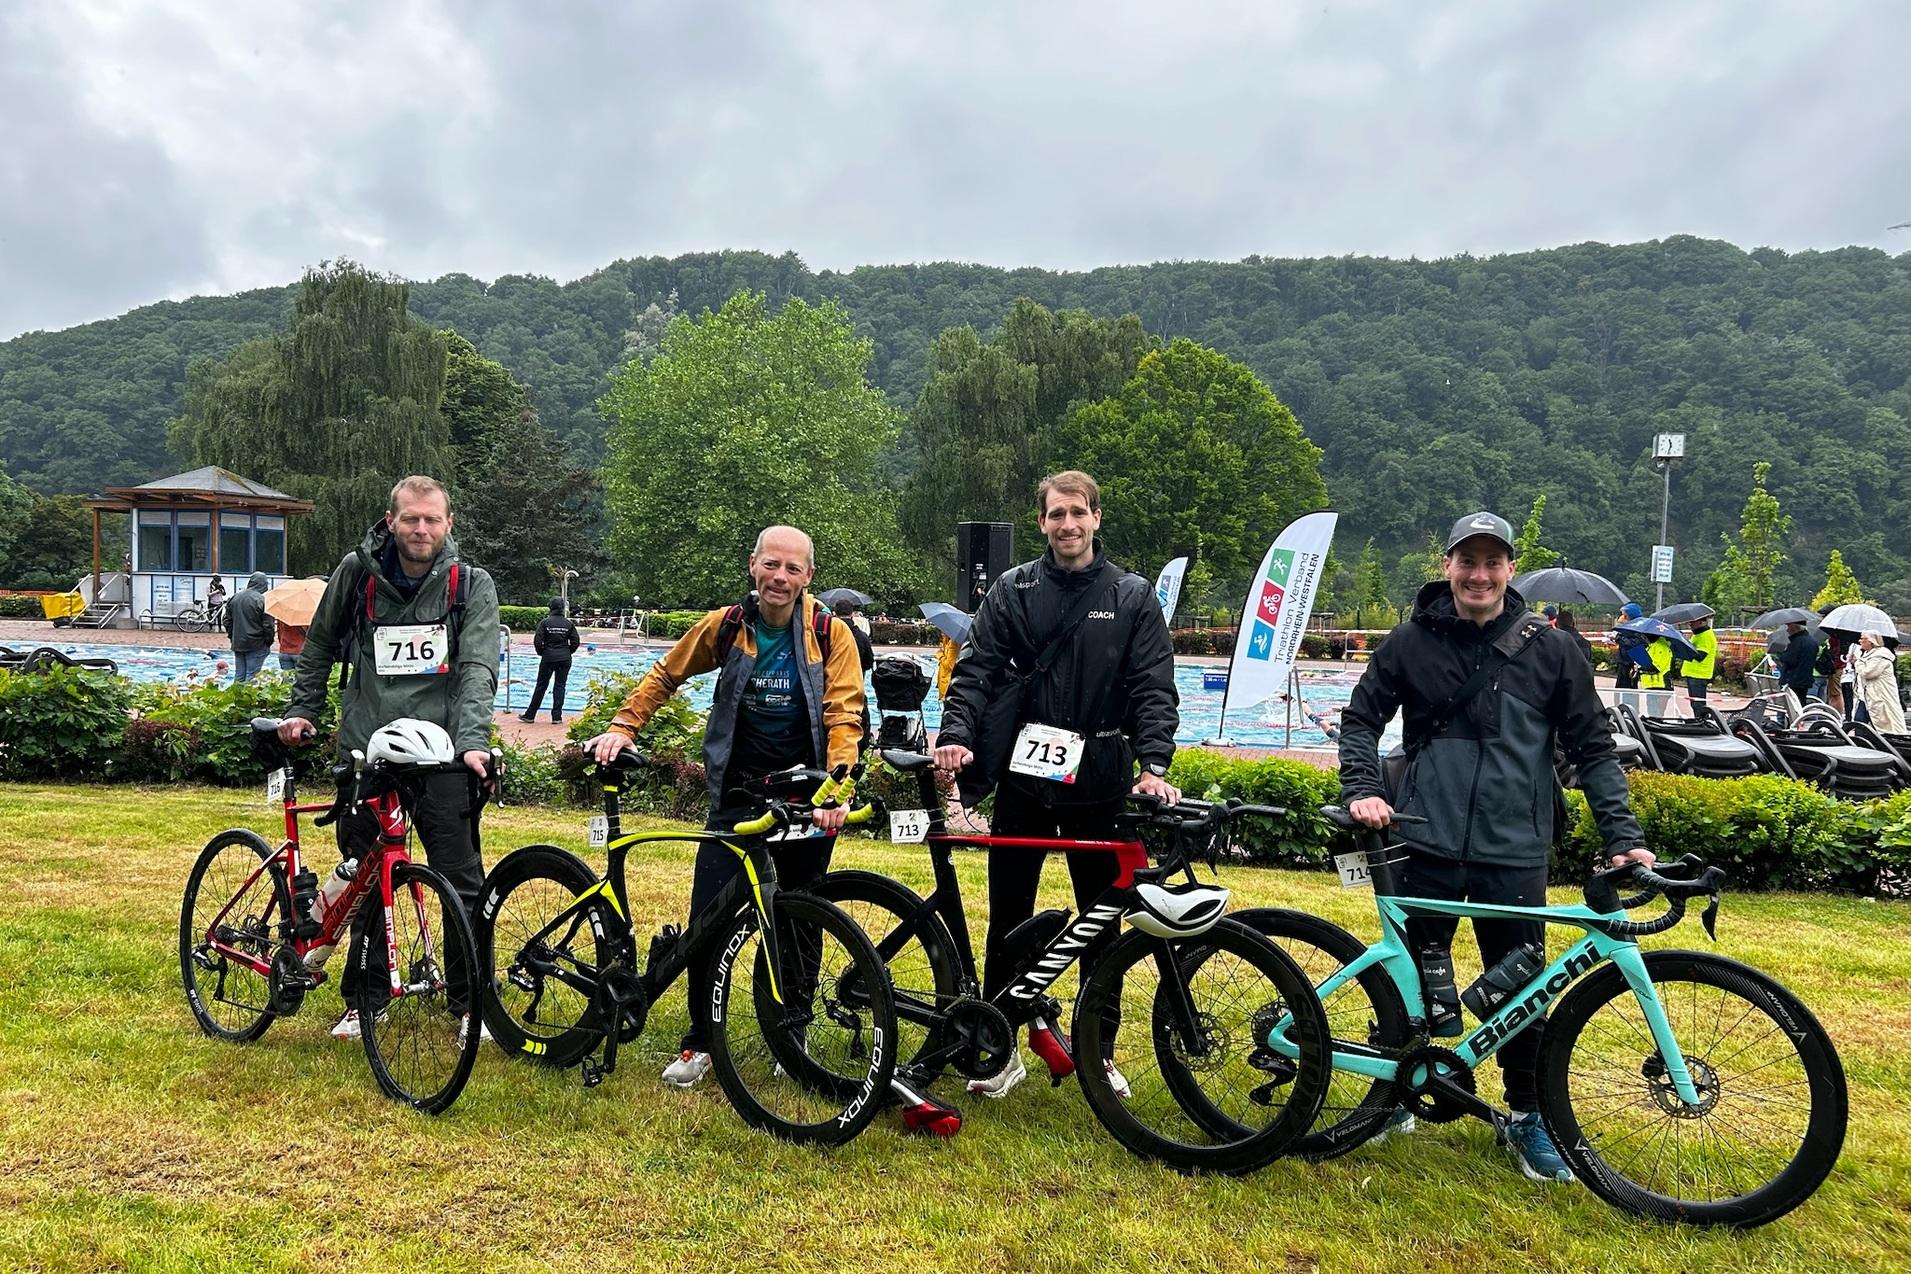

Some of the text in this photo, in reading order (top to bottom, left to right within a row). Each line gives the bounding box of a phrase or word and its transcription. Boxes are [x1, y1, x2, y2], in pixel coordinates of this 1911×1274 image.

[1088, 611, 1115, 620] COACH
[1274, 552, 1309, 663] Triathlon Verband
[1286, 553, 1320, 665] NORDRHEIN-WESTFALEN
[388, 640, 435, 661] 716
[1026, 740, 1067, 766] 713
[270, 781, 280, 795] 716
[593, 829, 604, 841] 715
[897, 824, 920, 837] 713
[363, 935, 370, 948] DT
[384, 906, 398, 972] SIMPLON
[1009, 904, 1124, 999] CANYON
[712, 923, 750, 1023] EQUINOX
[1468, 940, 1602, 1059] Bianchi
[838, 1027, 883, 1129] EQUINOX
